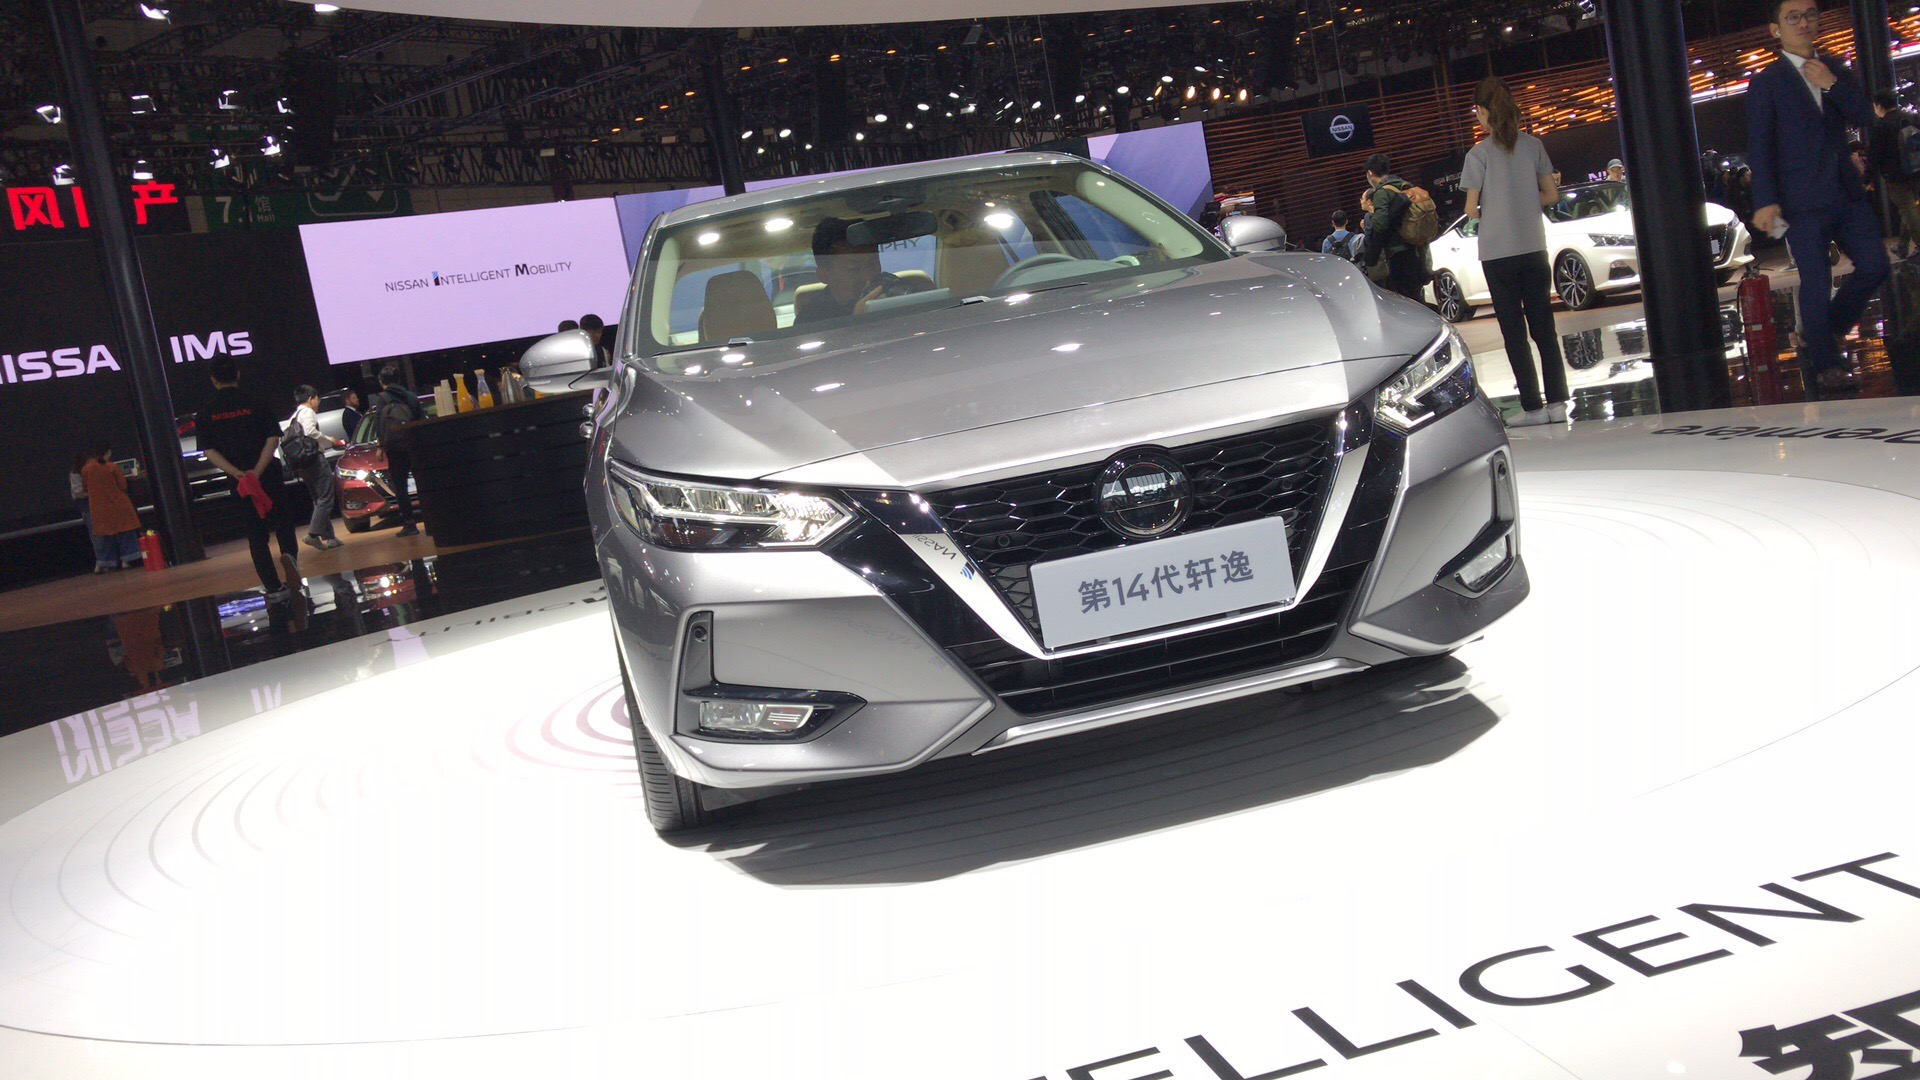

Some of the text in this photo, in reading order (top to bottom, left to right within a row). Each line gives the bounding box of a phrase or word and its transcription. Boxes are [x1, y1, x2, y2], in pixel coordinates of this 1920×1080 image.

[385, 278, 429, 293] NISSAN
[515, 261, 573, 278] MOBILITY
[0, 344, 122, 385] ISSA
[211, 409, 251, 421] NISSAN
[1077, 550, 1254, 614] 第14代轩逸
[1025, 851, 1920, 1080] ELLIGENT
